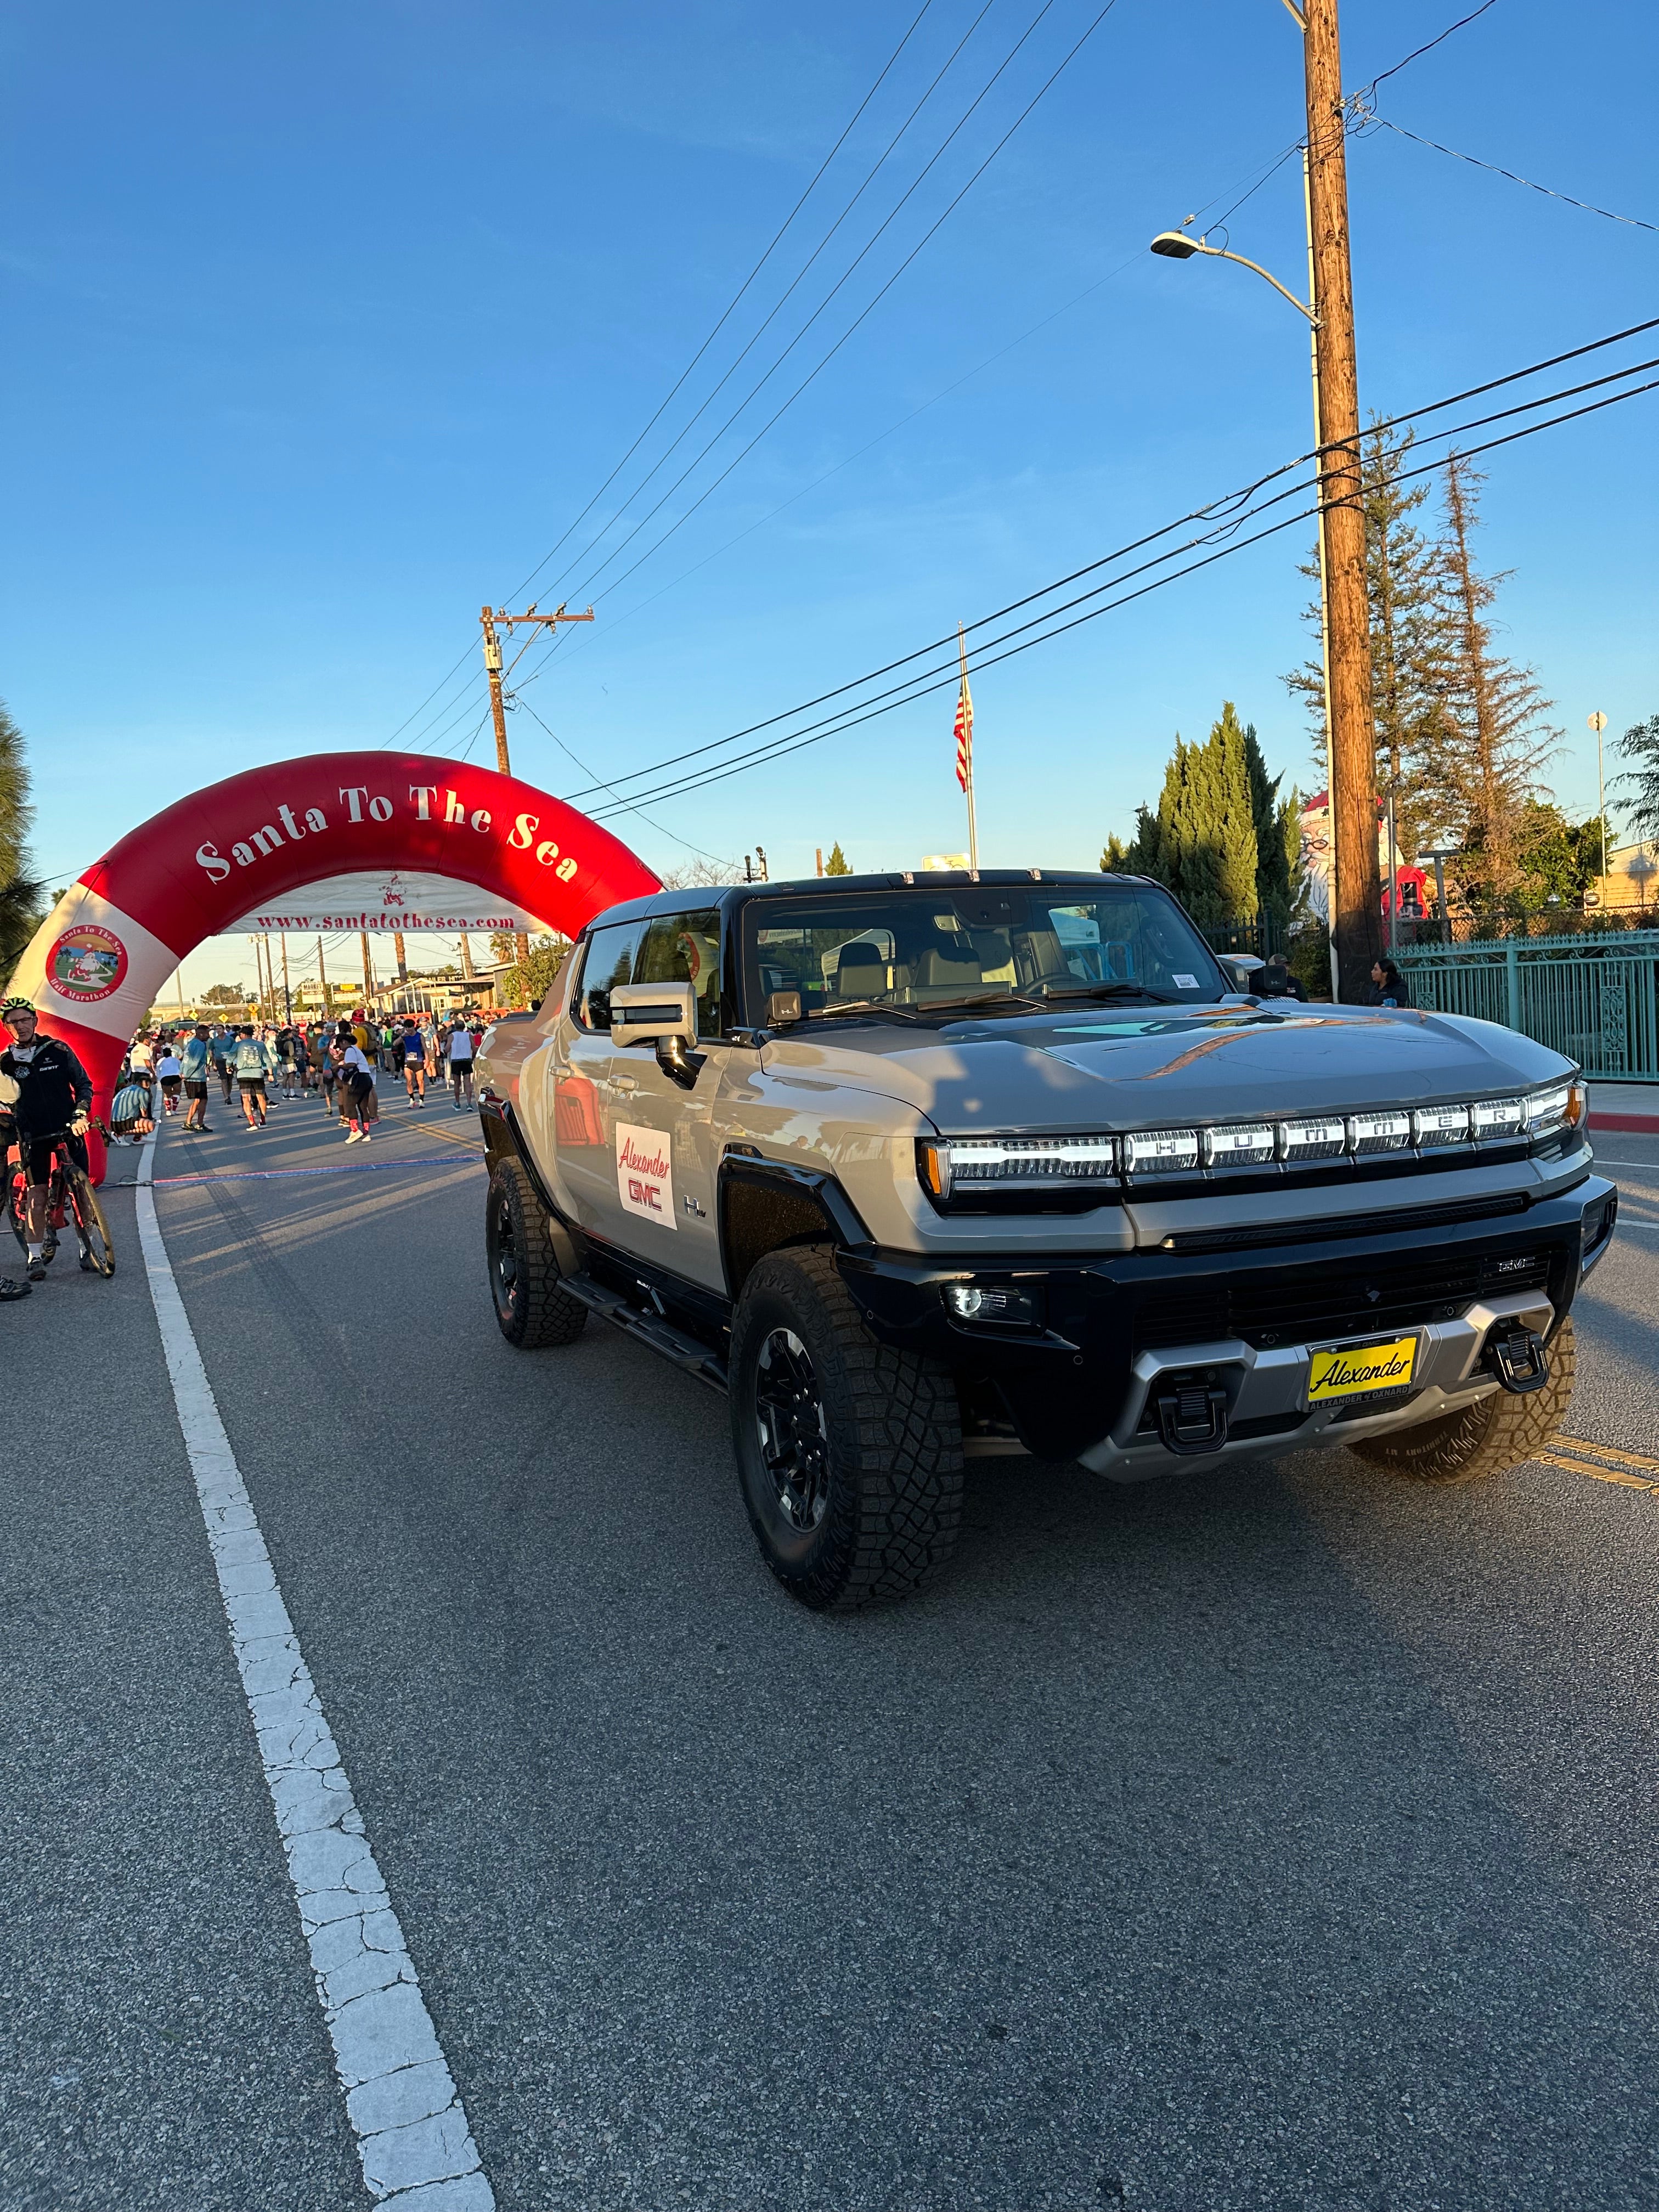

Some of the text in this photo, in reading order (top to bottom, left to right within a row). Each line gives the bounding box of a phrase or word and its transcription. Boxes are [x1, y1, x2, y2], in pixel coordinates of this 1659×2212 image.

[195, 785, 579, 885] Santa To The Sea
[257, 912, 515, 929] www.santatothesea.com
[59, 928, 81, 943] Santa
[99, 928, 112, 940] The
[112, 941, 122, 956] Sea
[50, 978, 110, 1001] Half Marathon
[618, 1137, 669, 1179] Alexander
[628, 1177, 662, 1212] GMC
[1499, 1256, 1535, 1272] GMC
[1310, 1352, 1410, 1393] Alexander
[1310, 1395, 1362, 1410] ALEXANDER
[1372, 1386, 1408, 1398] OXNARD
